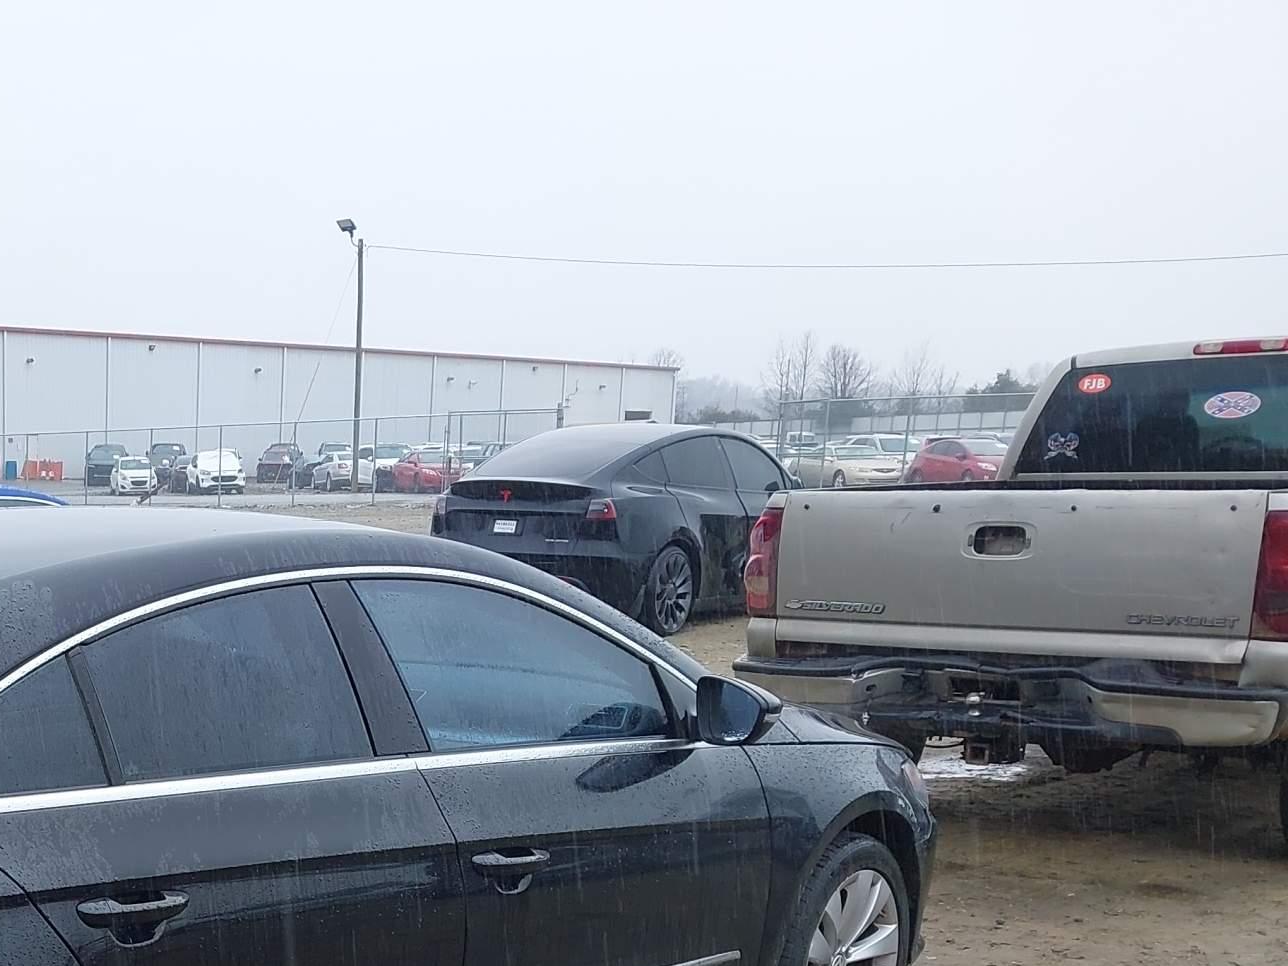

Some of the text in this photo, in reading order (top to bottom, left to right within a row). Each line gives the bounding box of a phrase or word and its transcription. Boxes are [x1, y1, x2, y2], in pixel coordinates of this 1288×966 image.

[1083, 377, 1107, 391] FJB
[800, 599, 886, 615] SILVERADO
[1127, 613, 1241, 629] CHEVROLET
